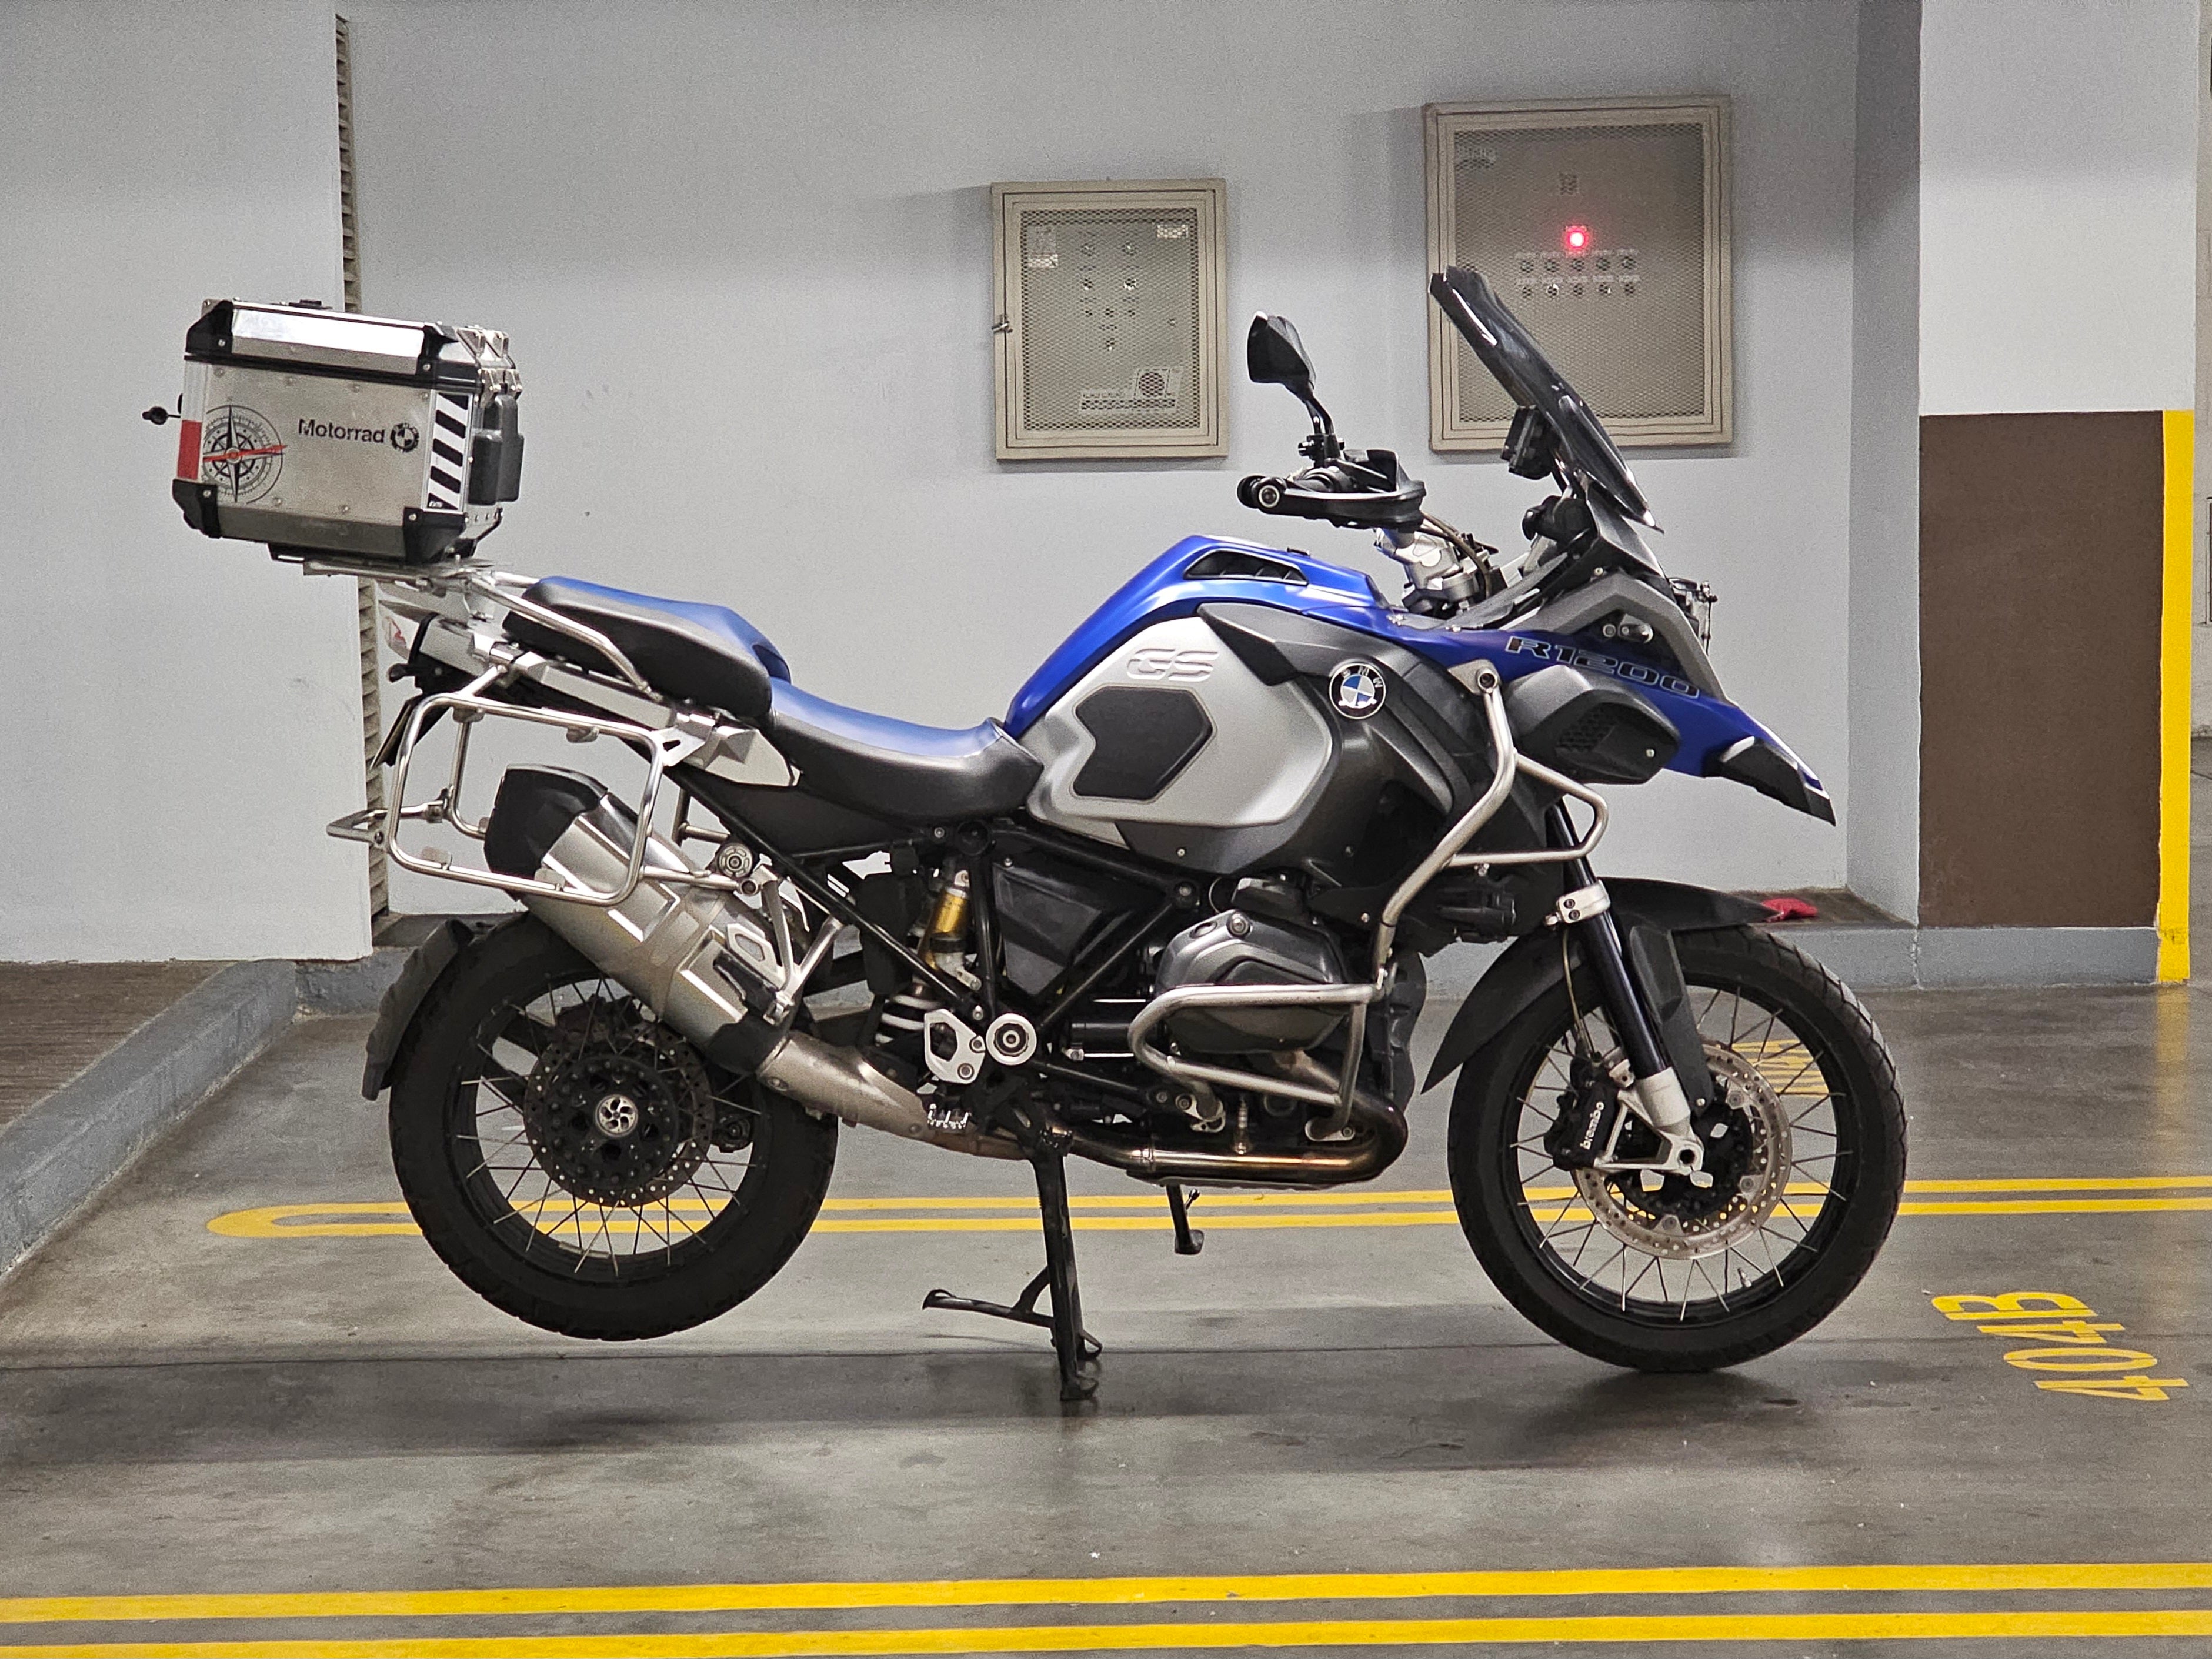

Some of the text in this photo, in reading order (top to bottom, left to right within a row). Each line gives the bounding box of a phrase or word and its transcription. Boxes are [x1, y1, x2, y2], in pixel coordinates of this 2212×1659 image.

[298, 419, 385, 443] Motorrad
[1127, 648, 1220, 682] GS
[1505, 636, 1700, 699] R1200
[1579, 1101, 1604, 1150] brembo
[1931, 1291, 2189, 1401] 404B
